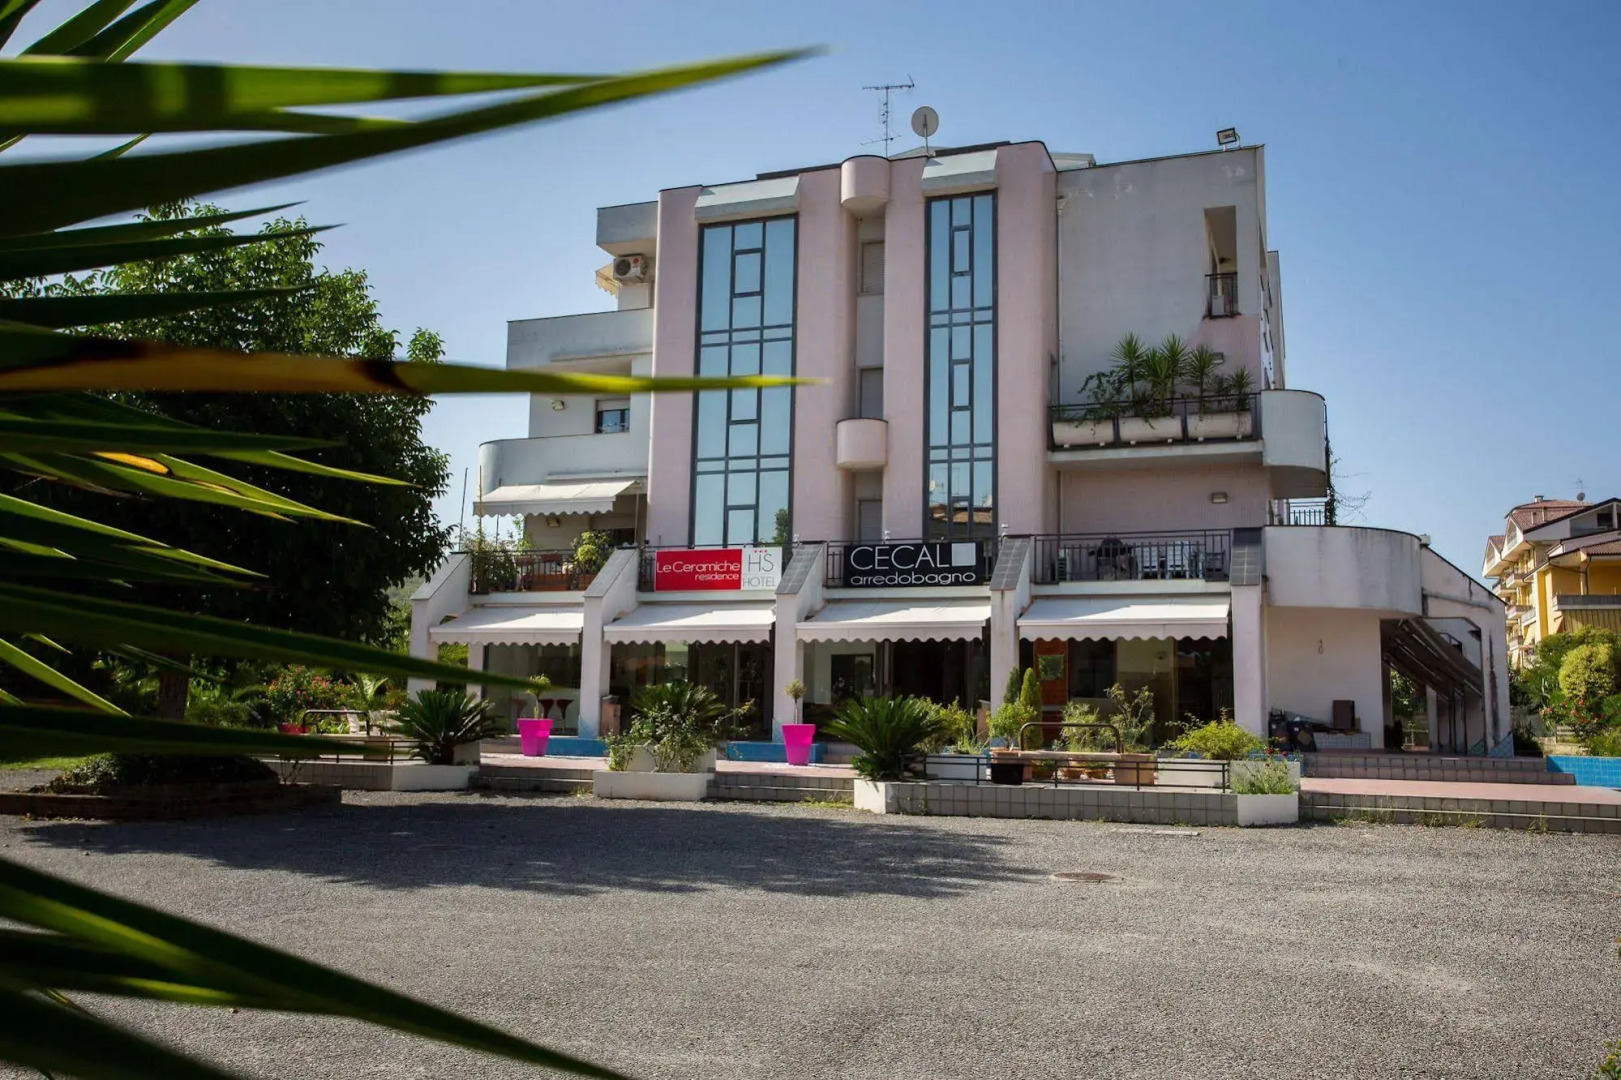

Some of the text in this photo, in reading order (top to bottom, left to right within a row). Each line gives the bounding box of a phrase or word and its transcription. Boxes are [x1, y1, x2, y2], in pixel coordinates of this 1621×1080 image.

[748, 553, 774, 572] HS
[850, 544, 950, 570] CECAL
[694, 572, 740, 581] residence
[743, 577, 777, 587] HOTEL
[850, 571, 976, 586] arredobagno
